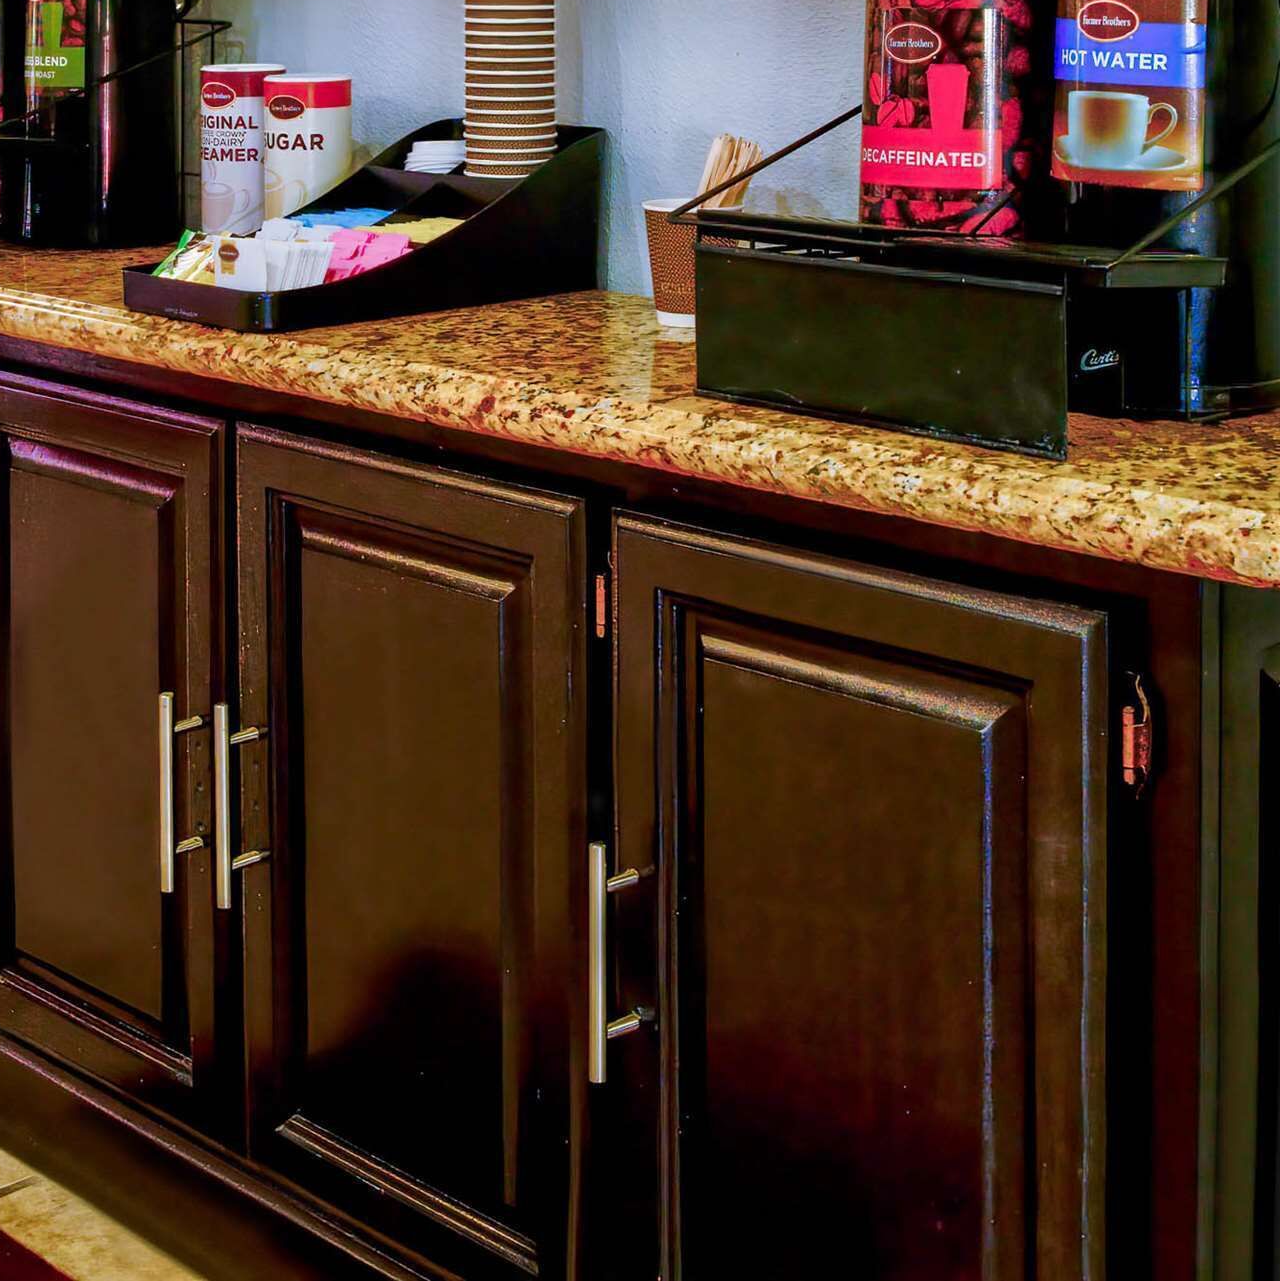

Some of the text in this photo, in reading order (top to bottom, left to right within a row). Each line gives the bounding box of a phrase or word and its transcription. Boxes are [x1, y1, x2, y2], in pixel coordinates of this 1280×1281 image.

[34, 56, 68, 67] BLEND
[1061, 48, 1168, 71] HOT WATER
[200, 147, 258, 162] EAMER
[863, 147, 987, 168] DECAFFEINATED
[1080, 349, 1120, 371] Curtis
